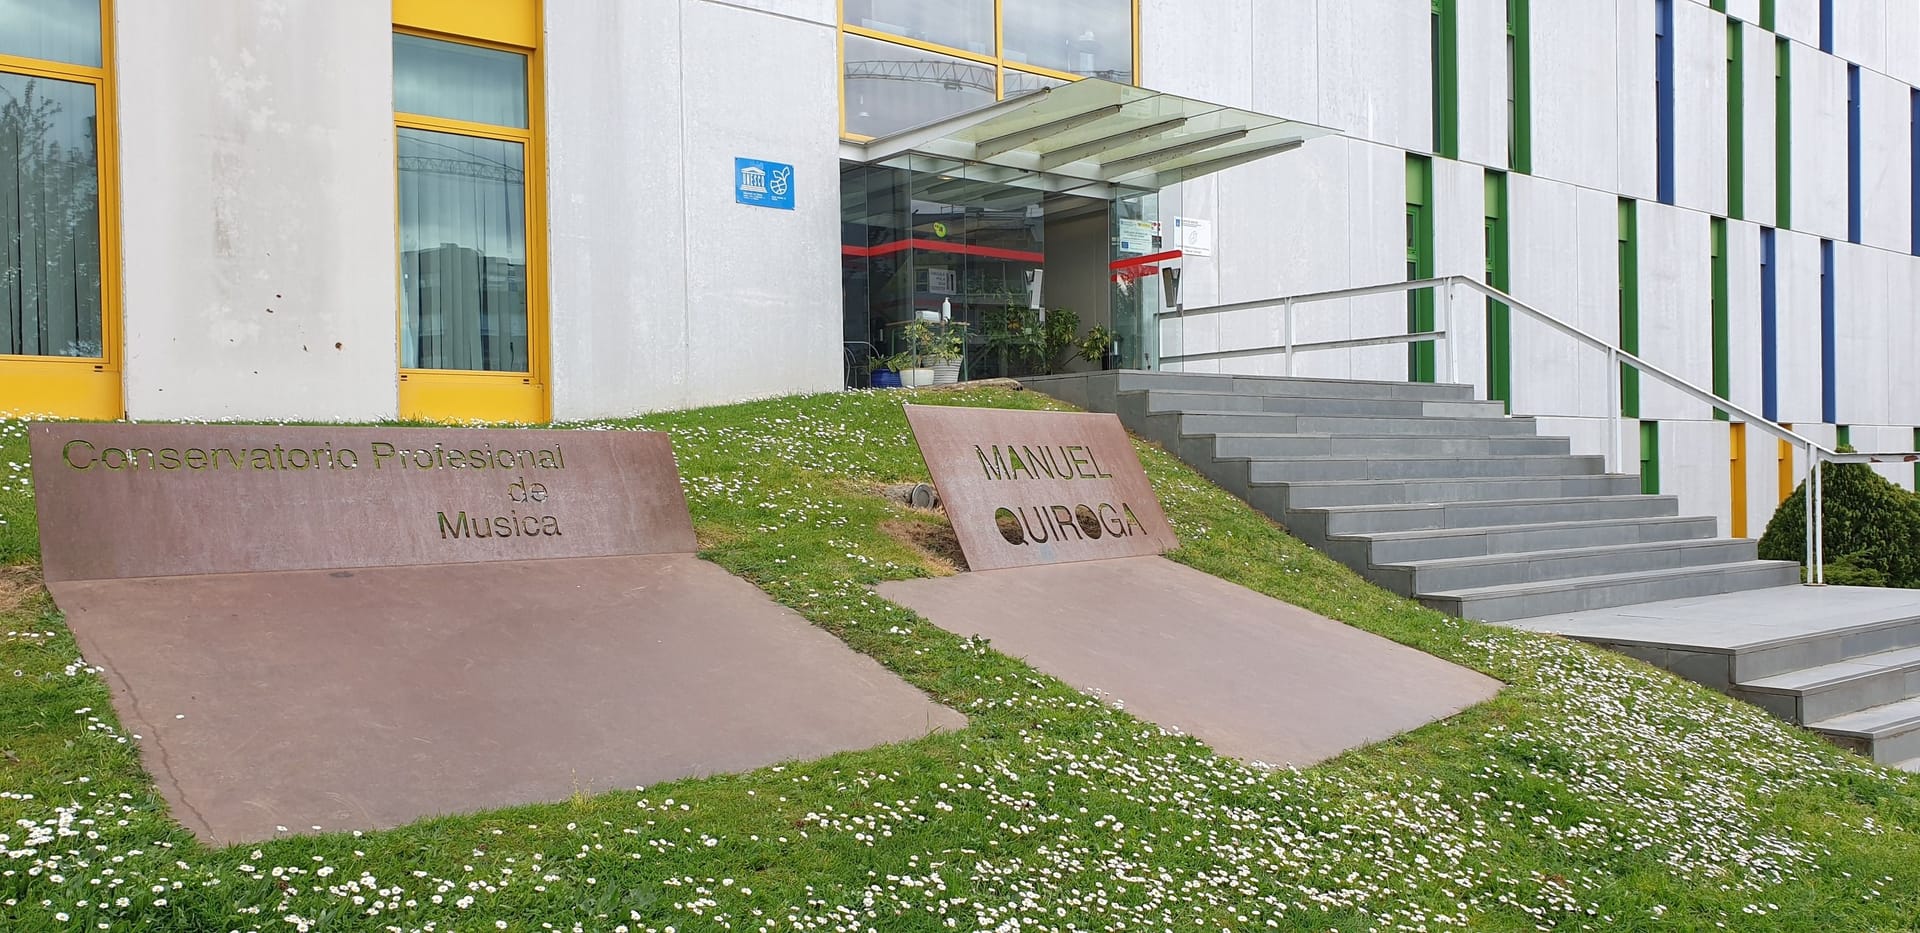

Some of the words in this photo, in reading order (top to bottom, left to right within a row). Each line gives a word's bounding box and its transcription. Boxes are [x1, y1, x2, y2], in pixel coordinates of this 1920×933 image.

[62, 439, 358, 471] Conservatorio
[371, 442, 566, 471] Profesional
[972, 444, 1113, 481] MANUEL
[507, 476, 549, 503] de
[436, 510, 562, 540] Musica
[994, 502, 1148, 546] QUIROGA
